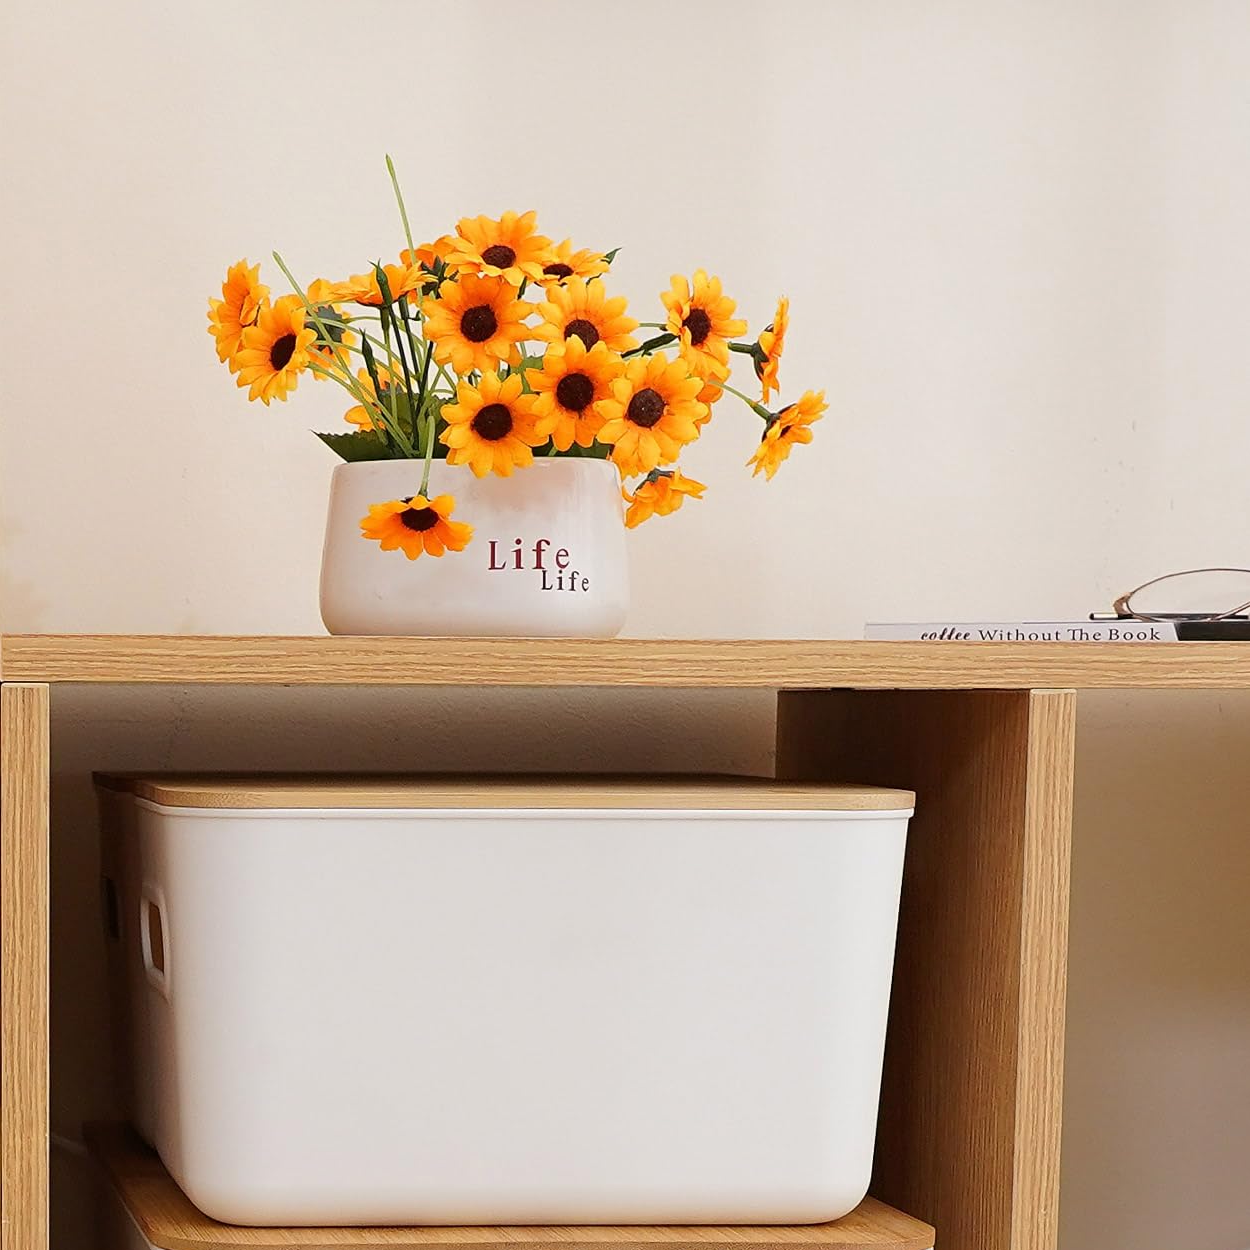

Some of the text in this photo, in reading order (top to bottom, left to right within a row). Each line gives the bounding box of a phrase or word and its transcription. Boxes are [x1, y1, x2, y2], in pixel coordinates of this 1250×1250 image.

[488, 538, 570, 570] Life
[541, 570, 590, 592] Life
[978, 629, 1061, 641] Without
[1067, 628, 1102, 641] The
[1108, 628, 1162, 641] Book
